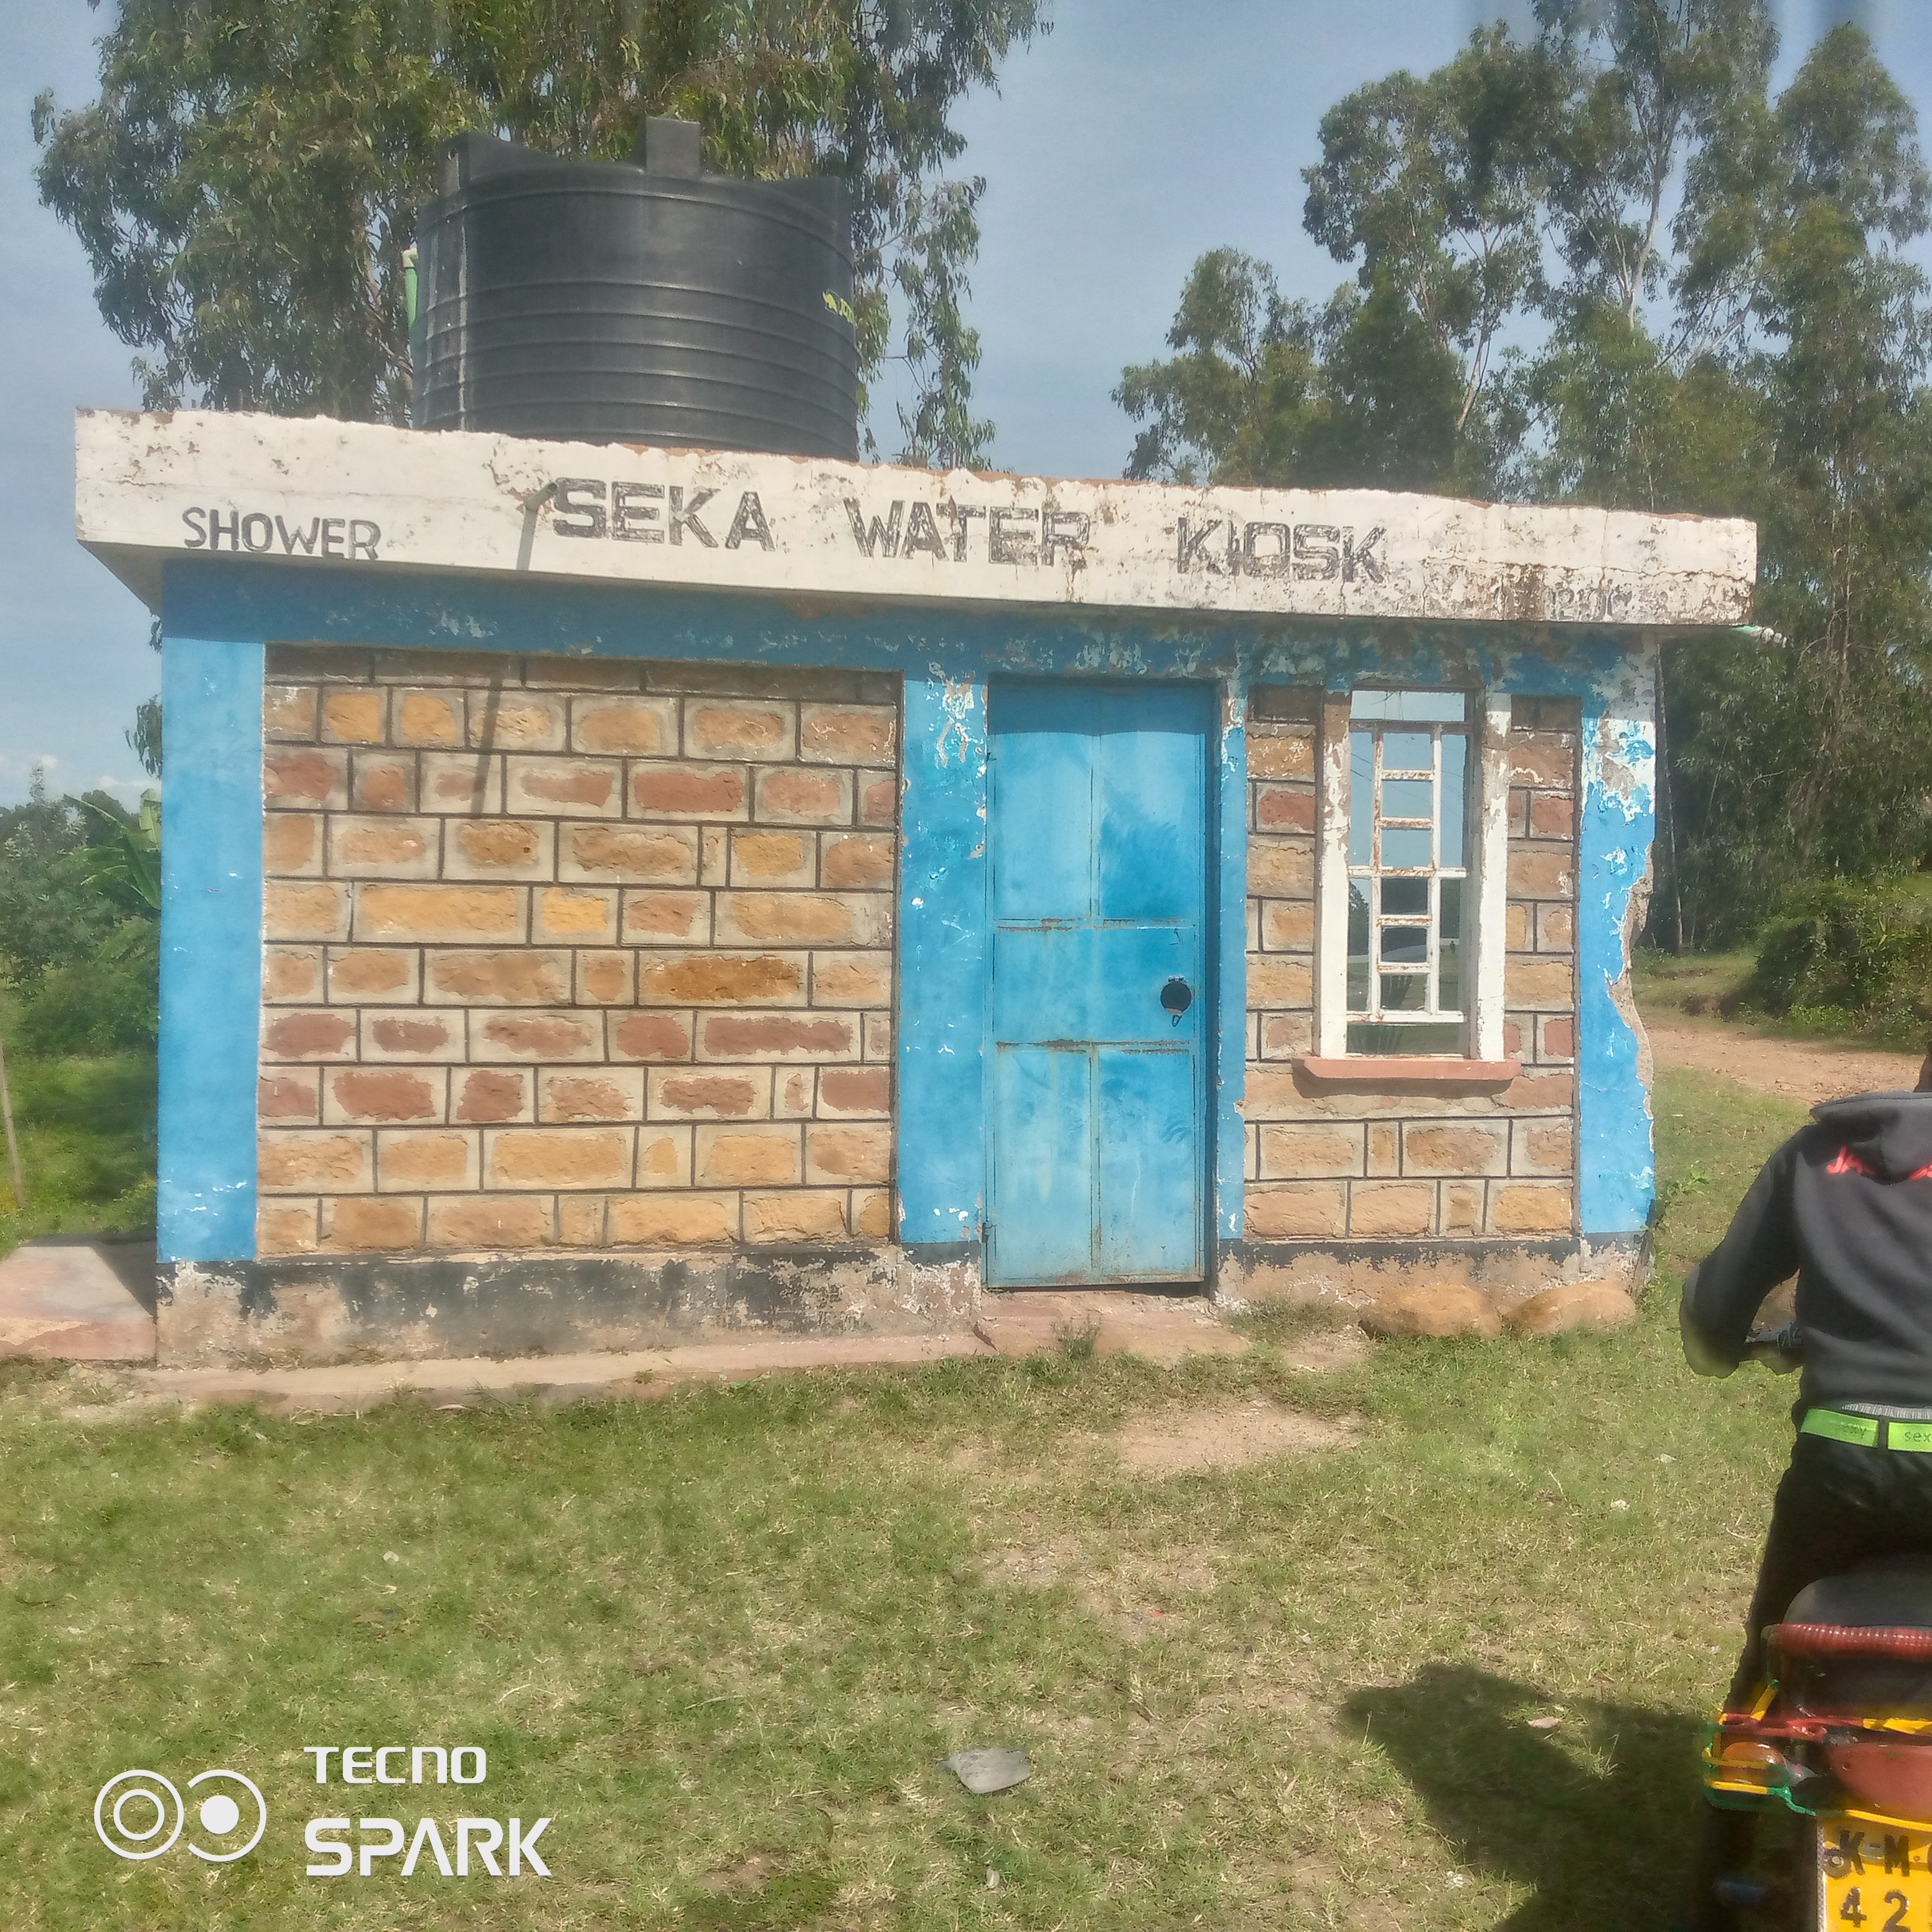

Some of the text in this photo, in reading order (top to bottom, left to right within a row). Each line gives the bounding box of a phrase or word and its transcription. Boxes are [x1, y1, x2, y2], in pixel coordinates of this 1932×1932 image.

[182, 506, 382, 560] SHOWER
[553, 477, 1387, 583] SEKA WATER KIOSK
[1840, 1829, 1932, 1877] KM
